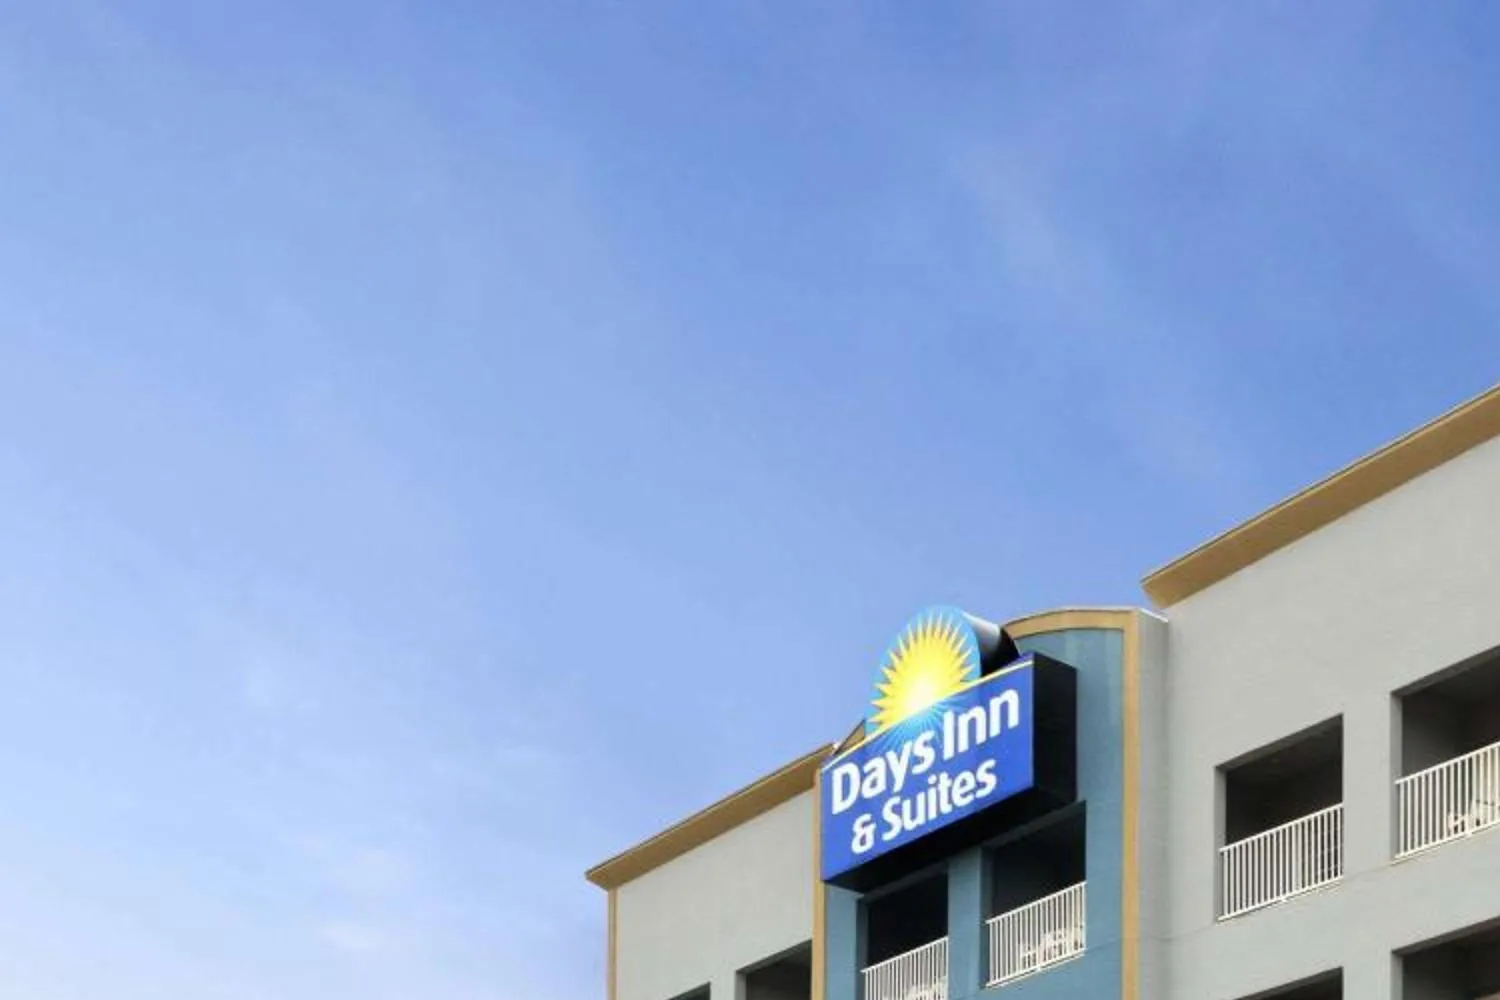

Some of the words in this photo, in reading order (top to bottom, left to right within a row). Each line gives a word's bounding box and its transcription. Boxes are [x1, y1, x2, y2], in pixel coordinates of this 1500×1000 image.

[831, 730, 936, 816] Days
[941, 688, 1020, 760] Inn
[851, 813, 877, 854] &
[881, 758, 998, 841] Suites
